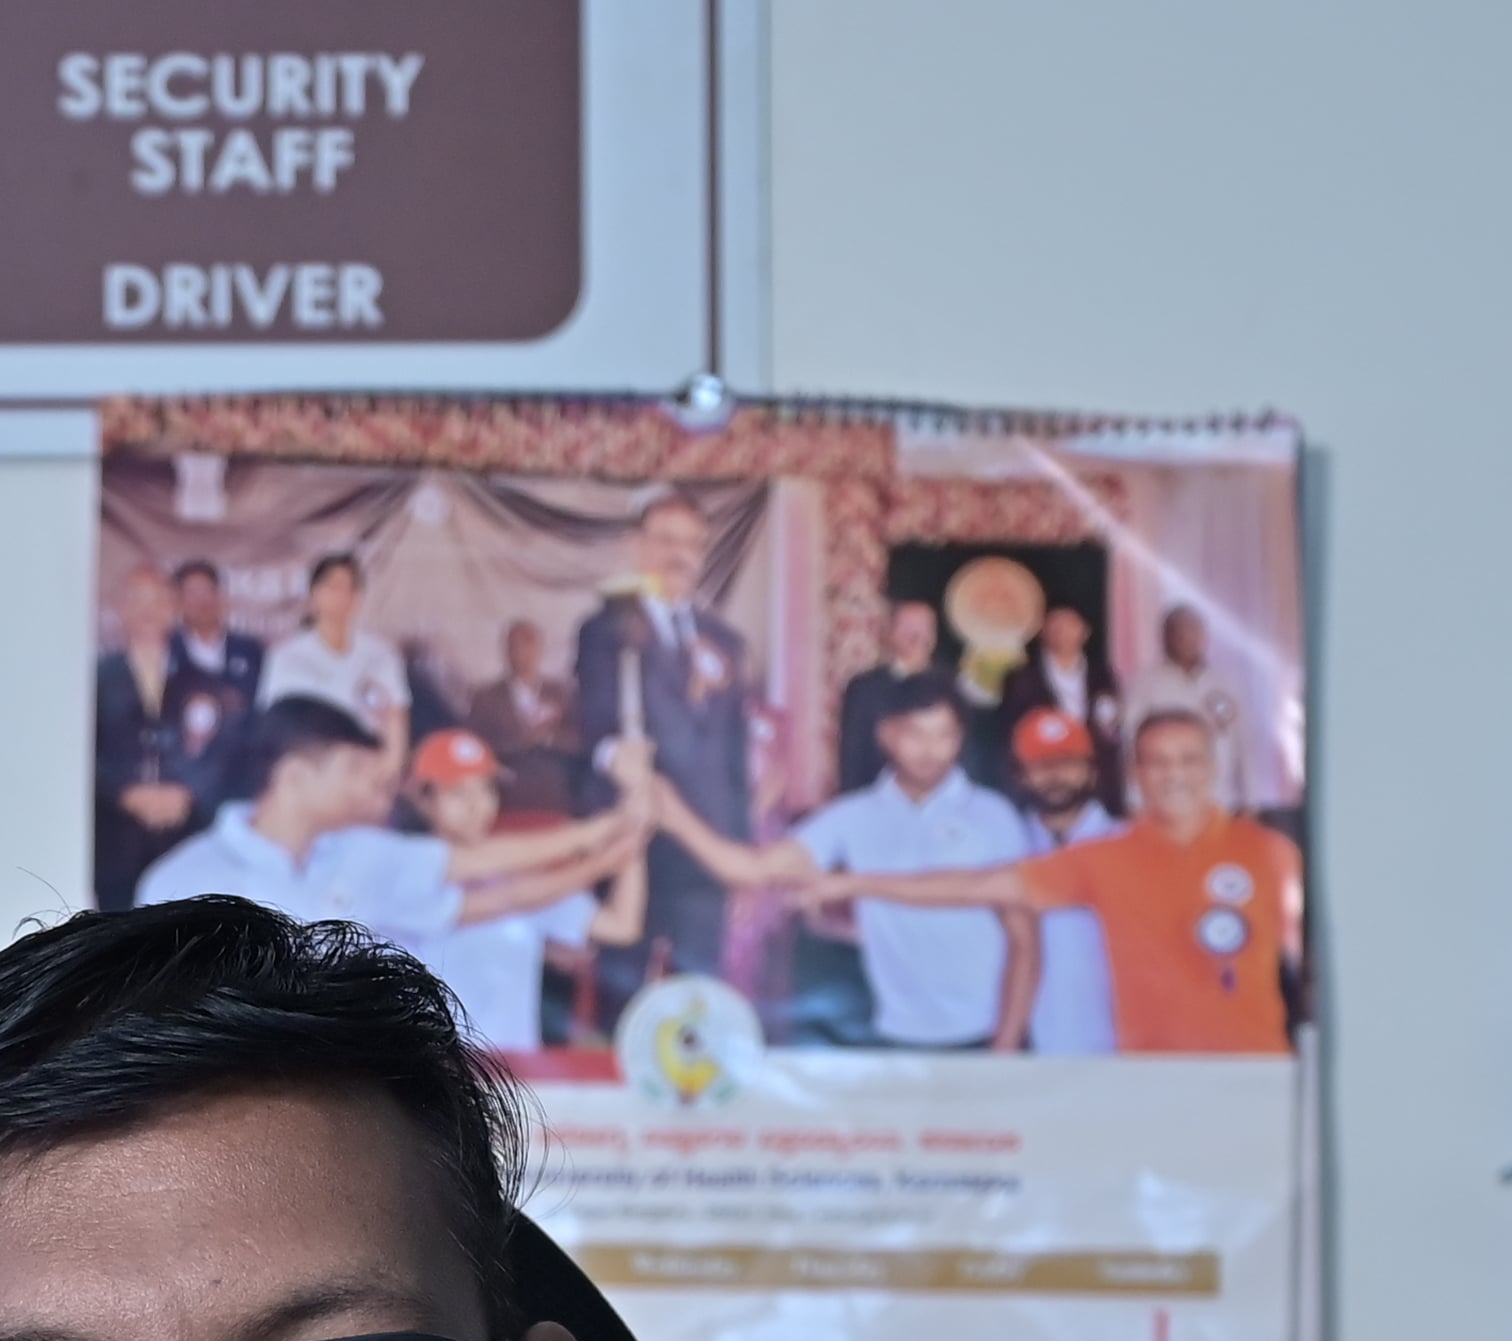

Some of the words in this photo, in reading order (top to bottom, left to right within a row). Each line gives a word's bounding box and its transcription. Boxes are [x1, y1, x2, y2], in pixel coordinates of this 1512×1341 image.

[57, 52, 424, 120] SECURITY
[130, 128, 355, 194] STAFF
[102, 263, 384, 328] DRIVER
